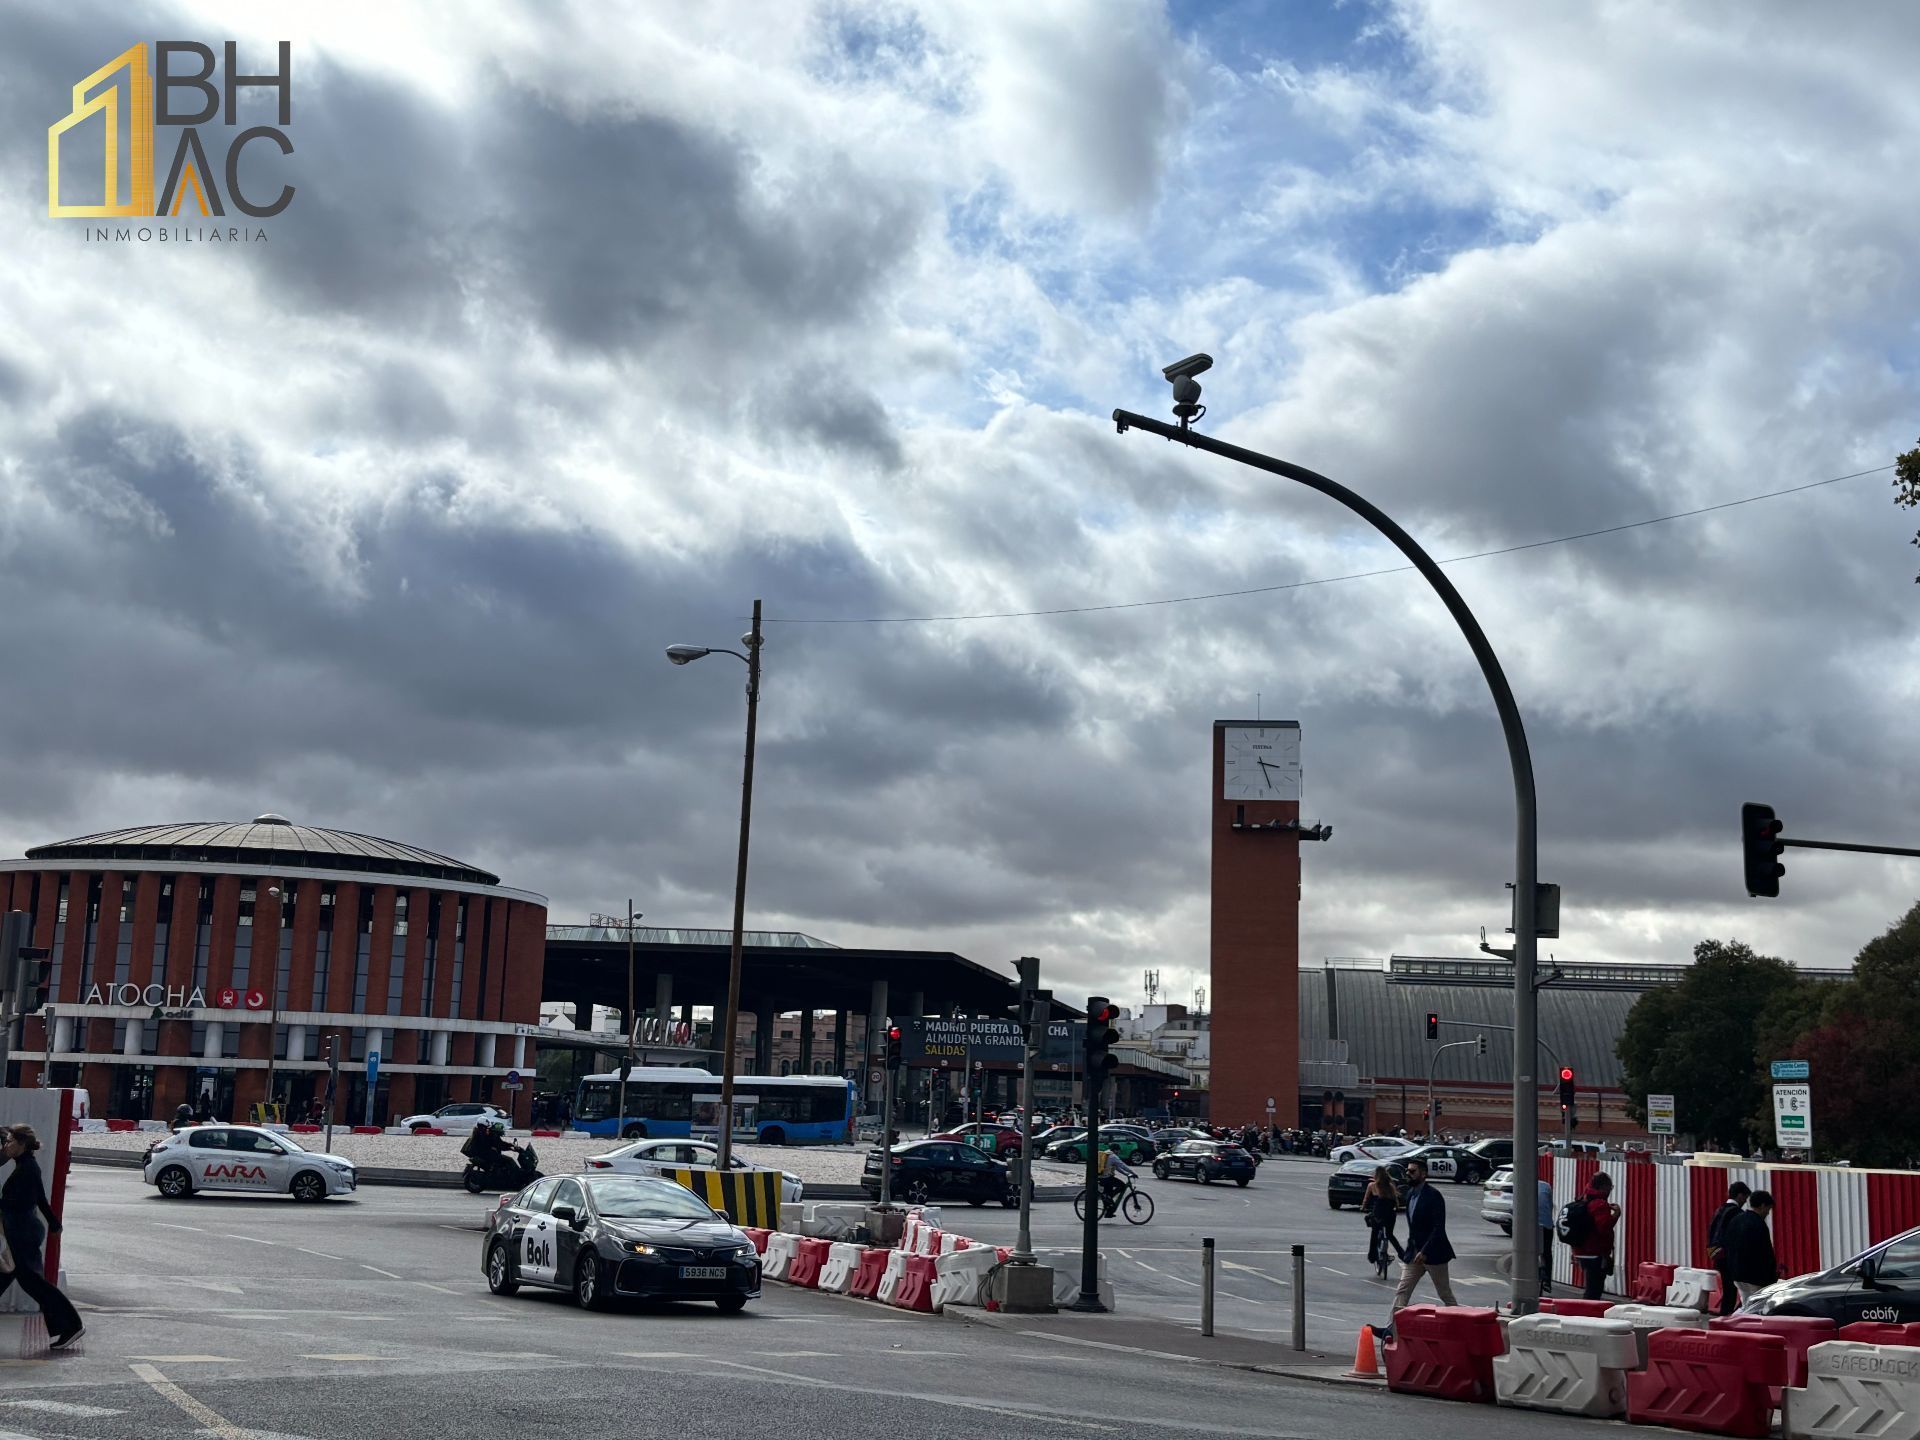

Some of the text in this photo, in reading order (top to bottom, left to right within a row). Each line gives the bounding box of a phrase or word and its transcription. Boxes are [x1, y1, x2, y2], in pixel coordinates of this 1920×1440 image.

[85, 983, 207, 1008] ATOCHA
[164, 1009, 194, 1019] adif
[925, 1021, 967, 1033] MADRID
[970, 1022, 1009, 1034] PUERTA
[925, 1033, 1027, 1046] ALMUDENA GRANDE
[925, 1045, 966, 1056] SALIDAS
[203, 1164, 267, 1180] LARA
[1431, 1161, 1453, 1172] Bolt
[527, 1237, 550, 1267] Bolt
[708, 1267, 726, 1278] NCS
[1861, 1306, 1899, 1322] cabify
